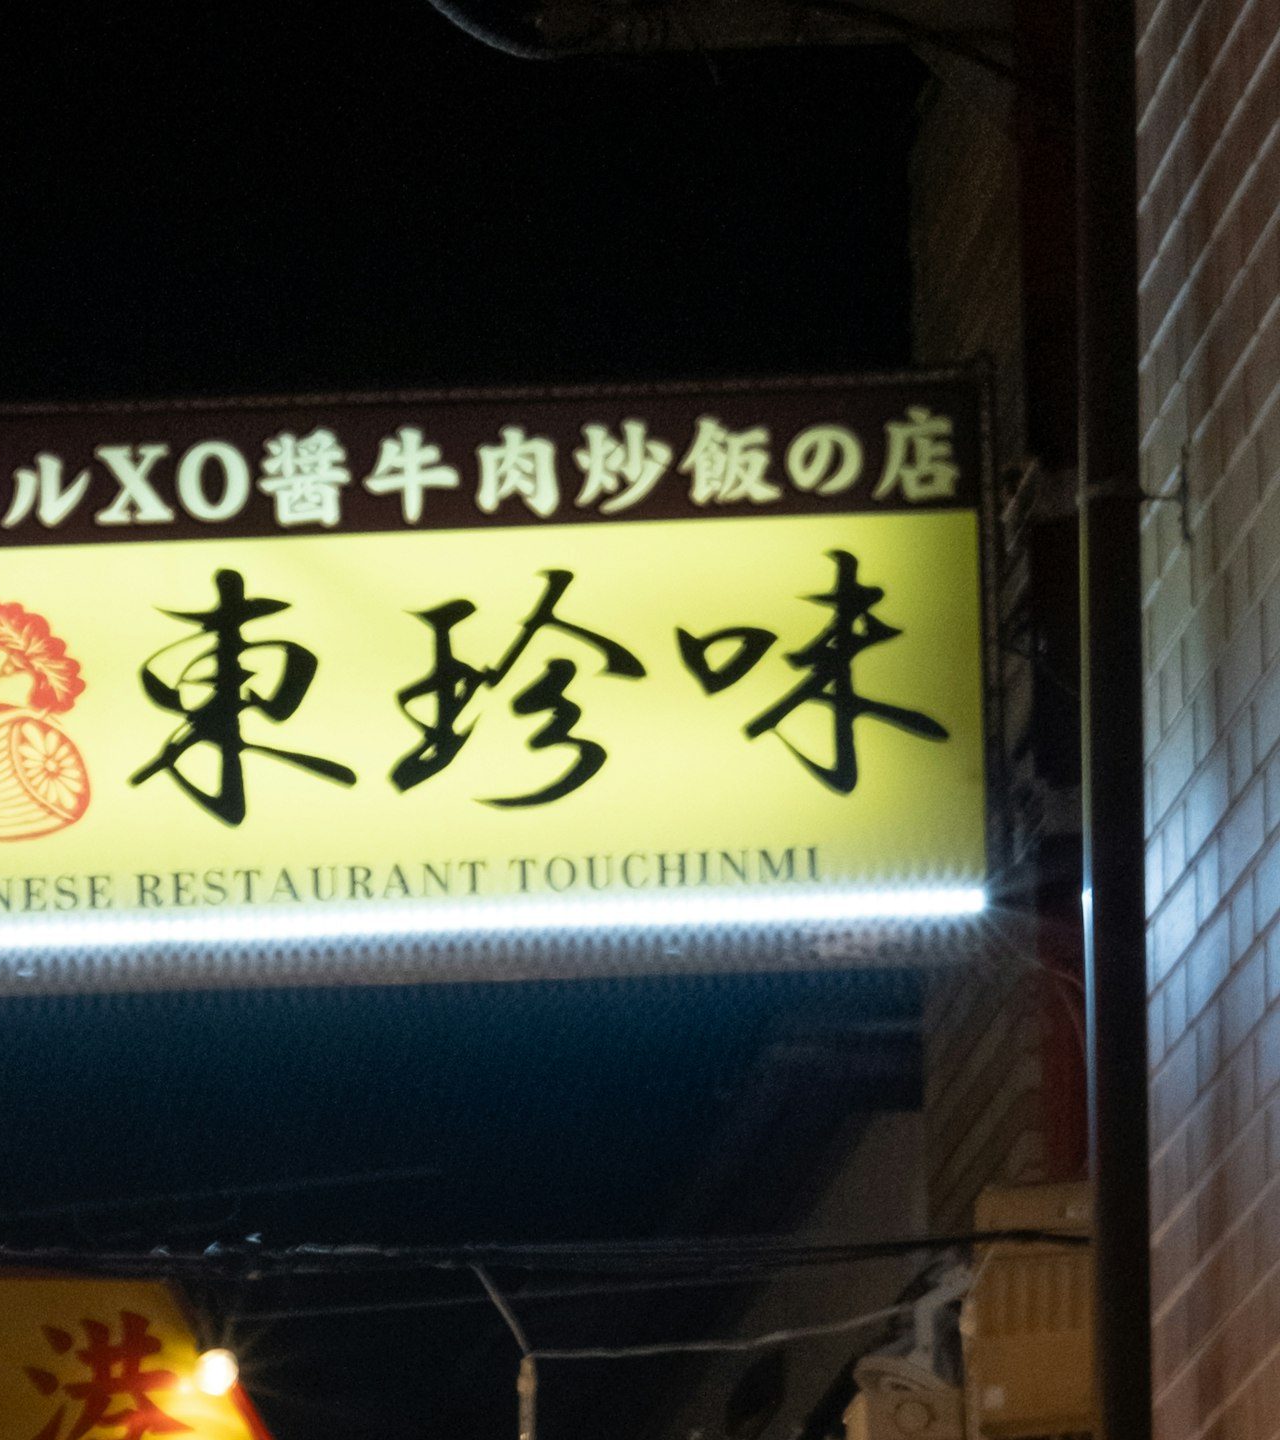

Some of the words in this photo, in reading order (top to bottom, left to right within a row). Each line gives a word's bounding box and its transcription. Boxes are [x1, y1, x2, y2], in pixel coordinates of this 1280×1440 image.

[128, 548, 950, 828] 東珍味
[137, 858, 489, 910] RESTAURANT
[510, 846, 824, 895] TOUCHINMI
